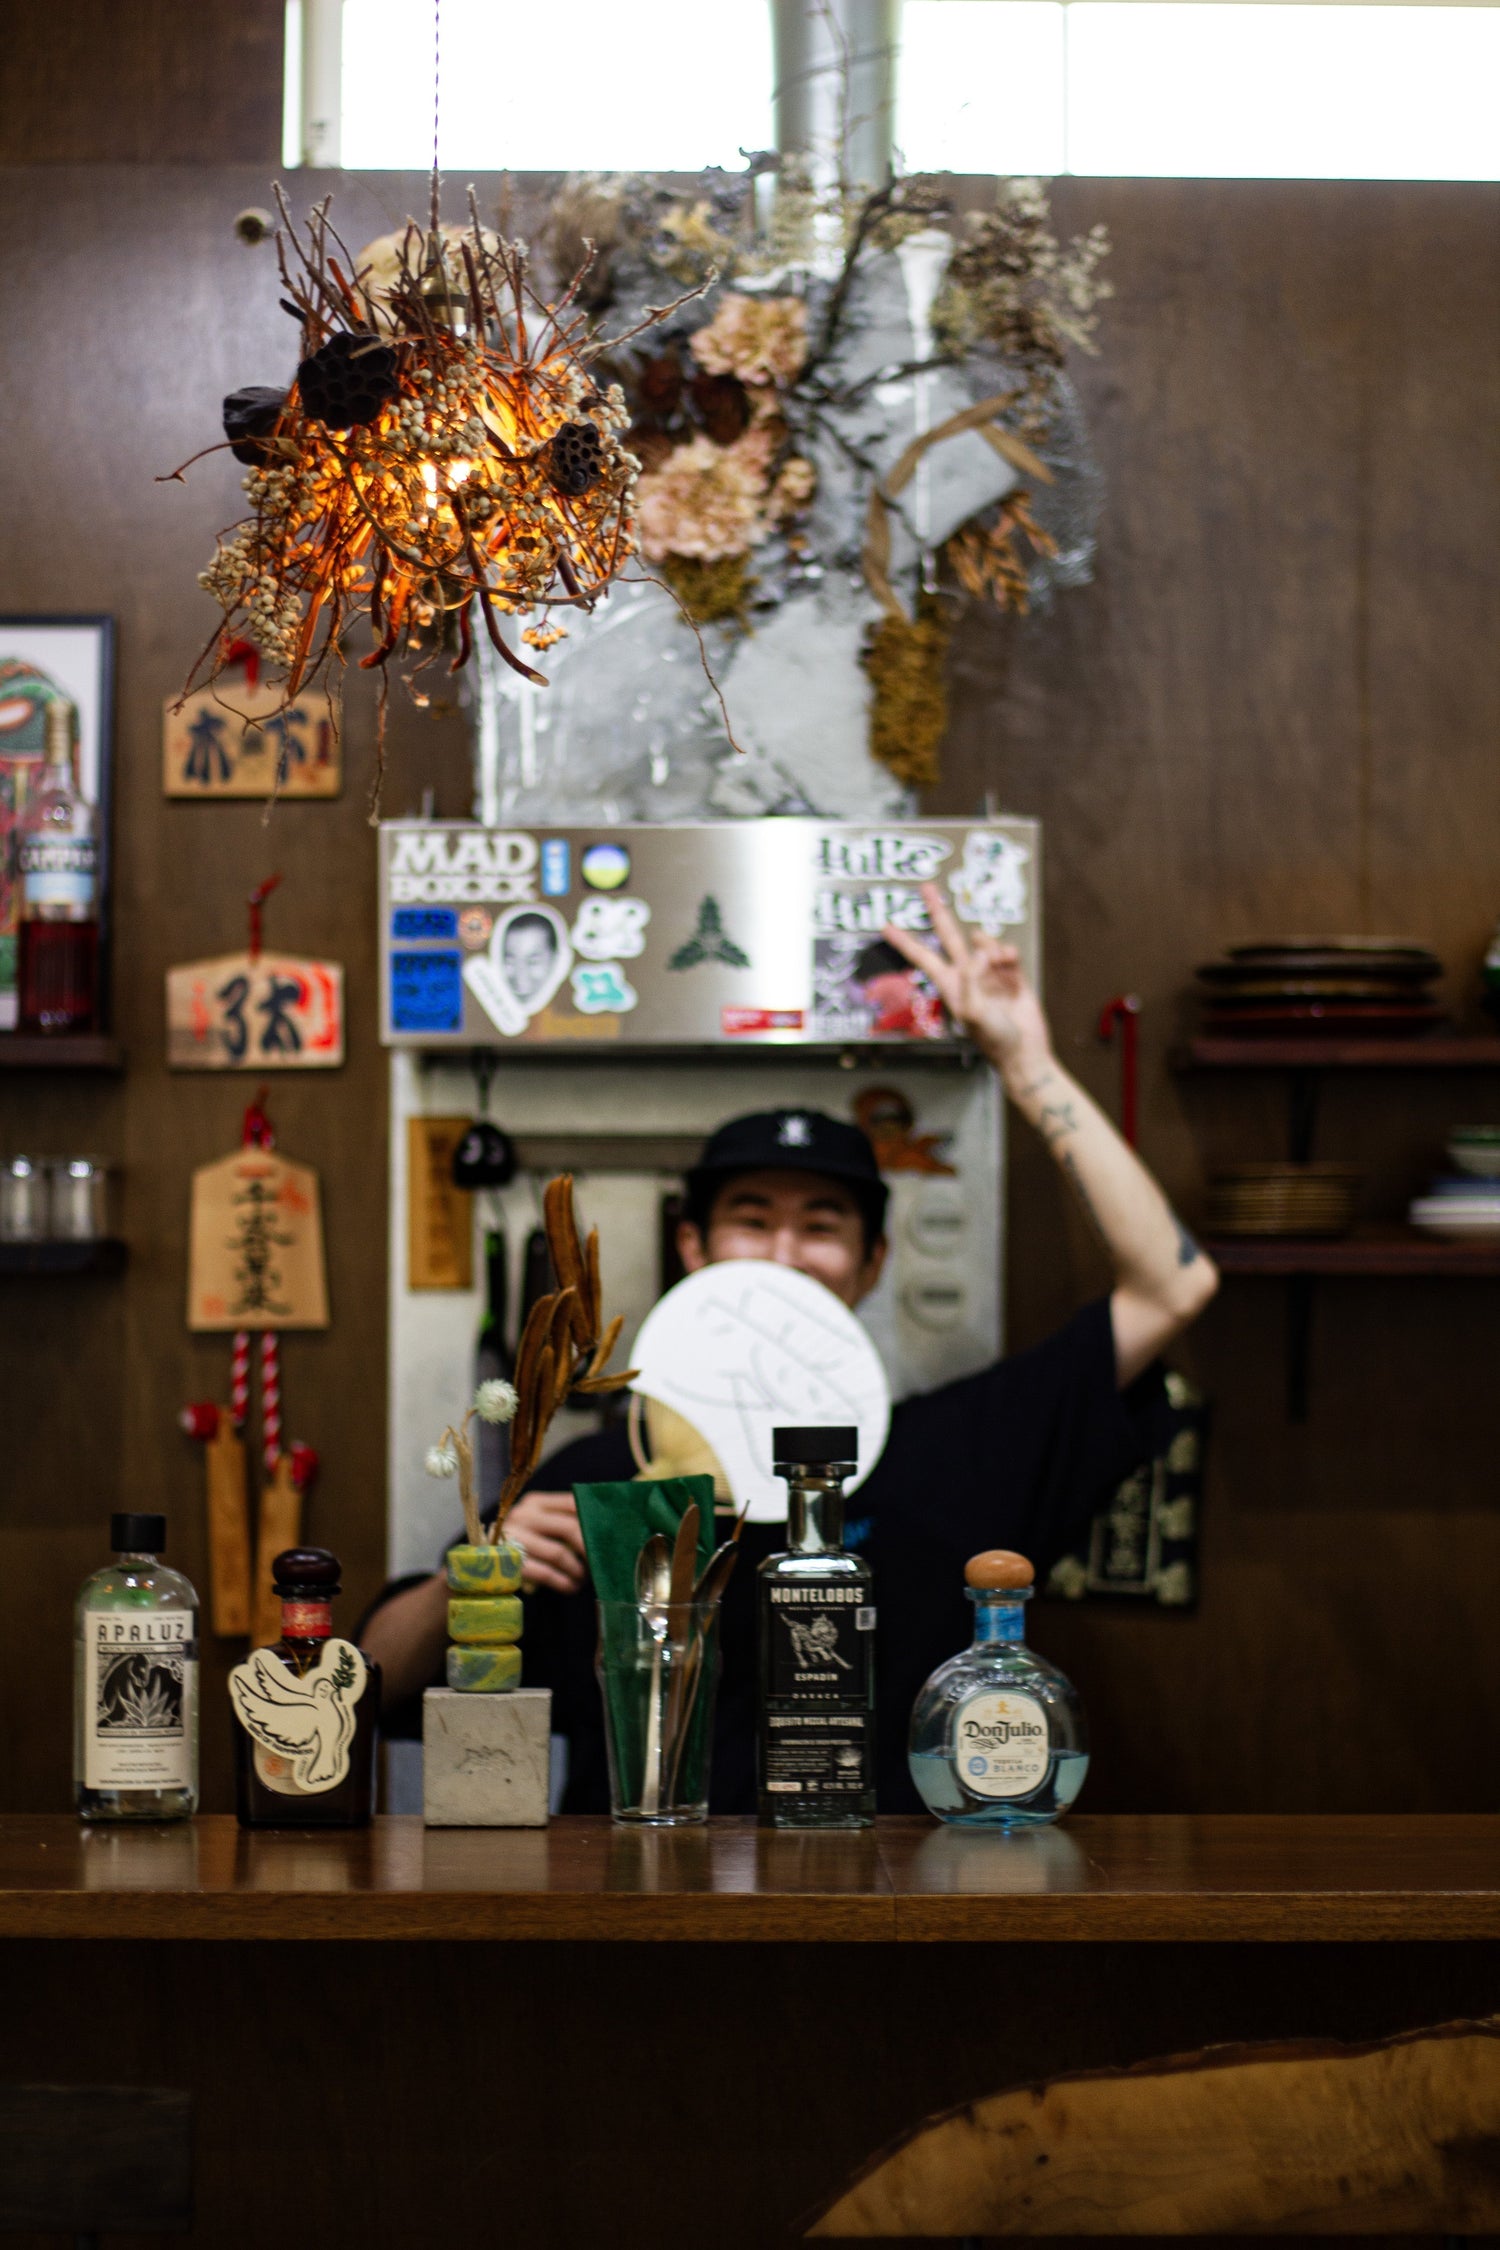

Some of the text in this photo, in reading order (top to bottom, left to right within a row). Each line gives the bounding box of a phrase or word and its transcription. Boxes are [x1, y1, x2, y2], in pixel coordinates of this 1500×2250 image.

[392, 833, 540, 874] MAD
[770, 1587, 865, 1603] MONTELOBOS
[97, 1624, 184, 1641] APALUZ
[963, 1720, 1043, 1745] Don Julio
[993, 1764, 1039, 1773] BLANCO
